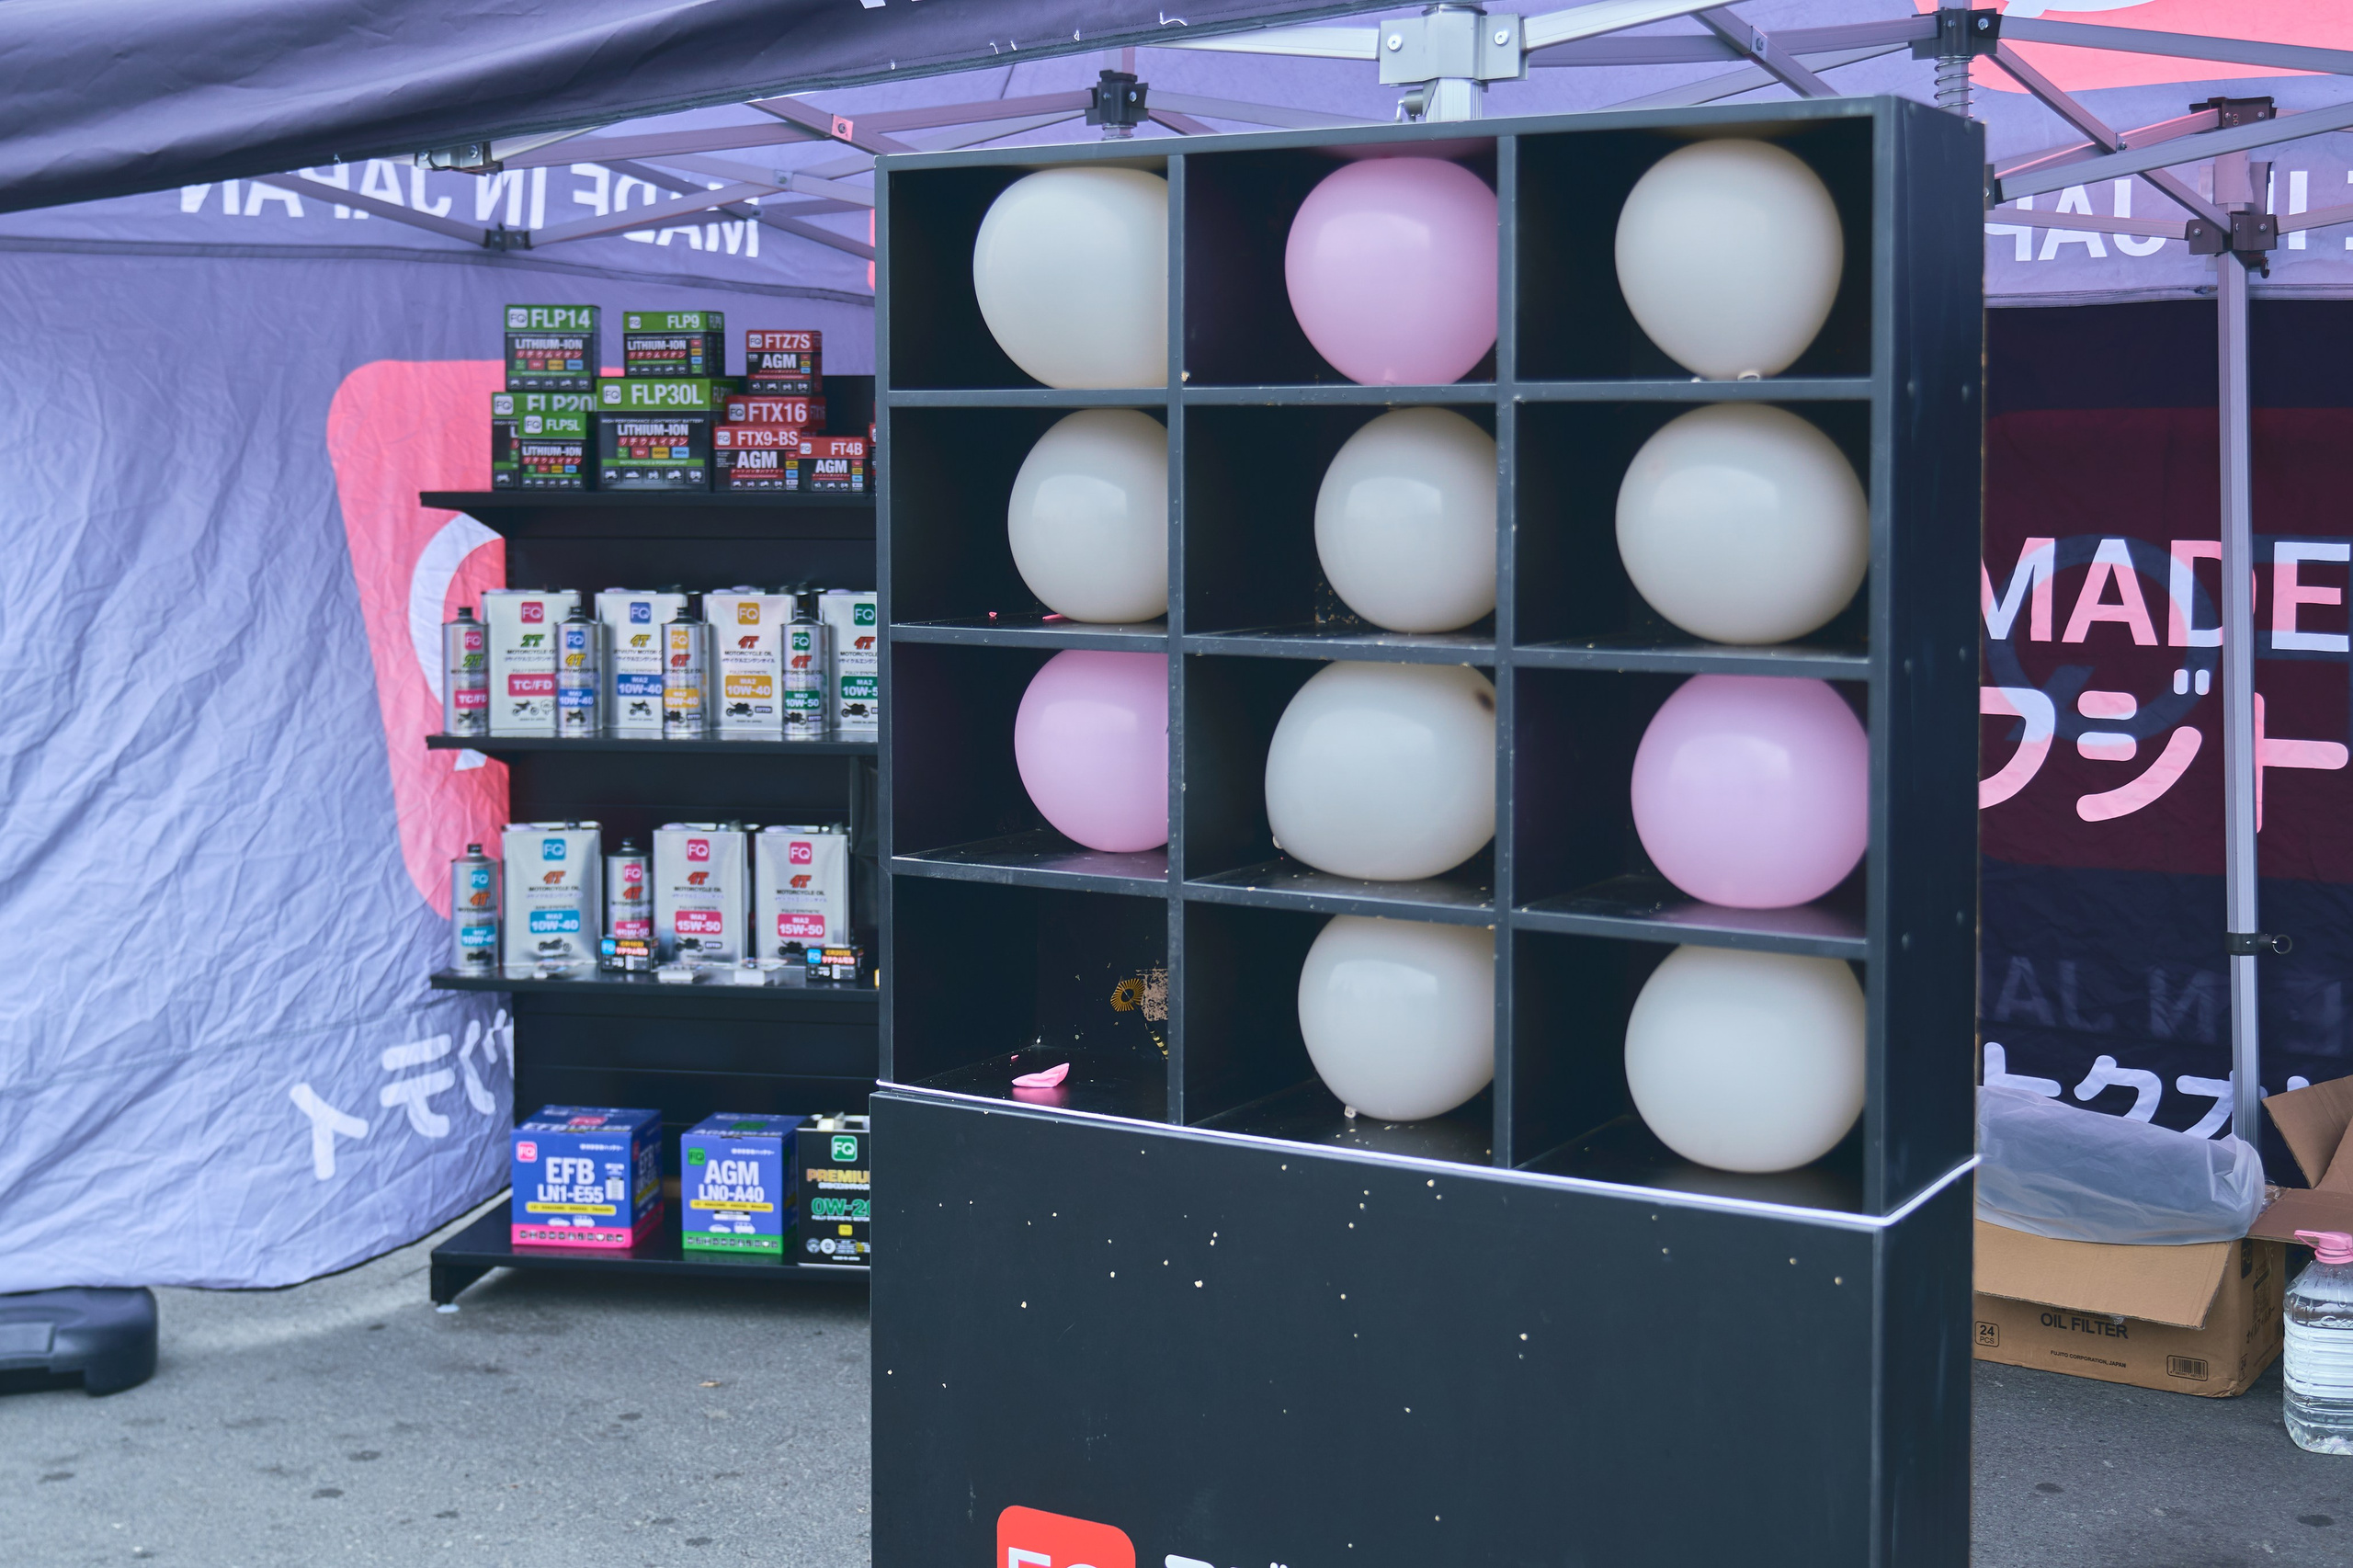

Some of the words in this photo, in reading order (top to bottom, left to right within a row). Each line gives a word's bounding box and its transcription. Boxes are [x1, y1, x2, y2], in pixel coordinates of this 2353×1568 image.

[530, 309, 591, 328] FLP14
[667, 315, 700, 329] FLP9
[515, 338, 583, 350] LITHIUM-ION
[627, 340, 687, 350] LITHIUM-ION
[765, 334, 810, 349] FTZ7S
[762, 354, 797, 369] AGM
[605, 391, 620, 399] FQ
[631, 384, 704, 404] FLP30L
[730, 408, 745, 417] FQ
[748, 403, 807, 423] FTX16
[546, 419, 581, 431] FLP5L
[617, 424, 689, 436] LITHIUM-ION
[620, 437, 688, 446] リチウムイオン
[737, 431, 799, 447] FTX9-BS
[522, 446, 583, 457] LITHIUM-ION
[831, 442, 863, 456] FT4B
[737, 451, 778, 469] AGM
[815, 460, 847, 474] AGM
[1981, 538, 2350, 652] MADE
[522, 607, 543, 619] FQ
[631, 607, 651, 619] FQ
[739, 608, 758, 619] FQ
[855, 608, 875, 620] FQ
[465, 635, 482, 646] FQ
[520, 634, 545, 647] 2T
[567, 635, 585, 645] FQ
[630, 634, 651, 647] 4T
[672, 635, 688, 645] FQ
[738, 635, 760, 649] 4T
[793, 636, 809, 646] FQ
[854, 636, 876, 650] 4T
[463, 653, 483, 667] 2T
[565, 653, 585, 667] 4T
[671, 653, 690, 667] 4T
[791, 655, 812, 669] 4T
[513, 679, 552, 690] TC/FD
[618, 684, 663, 694] 10W-40
[726, 686, 771, 696] 10W-40
[842, 686, 879, 697] 10W-5
[459, 695, 487, 703] TC/FD
[559, 696, 594, 704] 10W-40
[665, 697, 699, 706] 10W-40
[785, 699, 820, 708] 10W-50
[544, 844, 564, 856] FQ
[688, 845, 708, 857] FQ
[790, 847, 811, 859] FQ
[472, 874, 489, 884] FQ
[543, 870, 566, 884] 4T
[625, 868, 642, 879] FQ
[688, 871, 710, 885] 4T
[790, 874, 812, 889] 4T
[470, 892, 491, 906] 4T
[623, 886, 643, 900] 4T
[531, 920, 579, 931] 10W-40
[676, 921, 721, 932] 15W-50
[779, 924, 824, 935] 15W-50
[809, 952, 821, 960] FQ
[519, 1146, 536, 1157] FQ
[833, 1142, 856, 1154] FQ
[689, 1150, 705, 1162] FQ
[546, 1156, 596, 1185] EFB
[704, 1159, 759, 1186] AGM
[537, 1184, 604, 1203] LN1-E55
[1980, 1324, 1995, 1337] 24
[2040, 1312, 2067, 1330] OIL
[2071, 1317, 2129, 1339] FILTER
[1979, 1335, 1995, 1345] PCS
[2050, 1350, 2068, 1358] FUJITO
[2069, 1354, 2108, 1366] CORPORATION,
[2109, 1360, 2127, 1369] JAPAN
